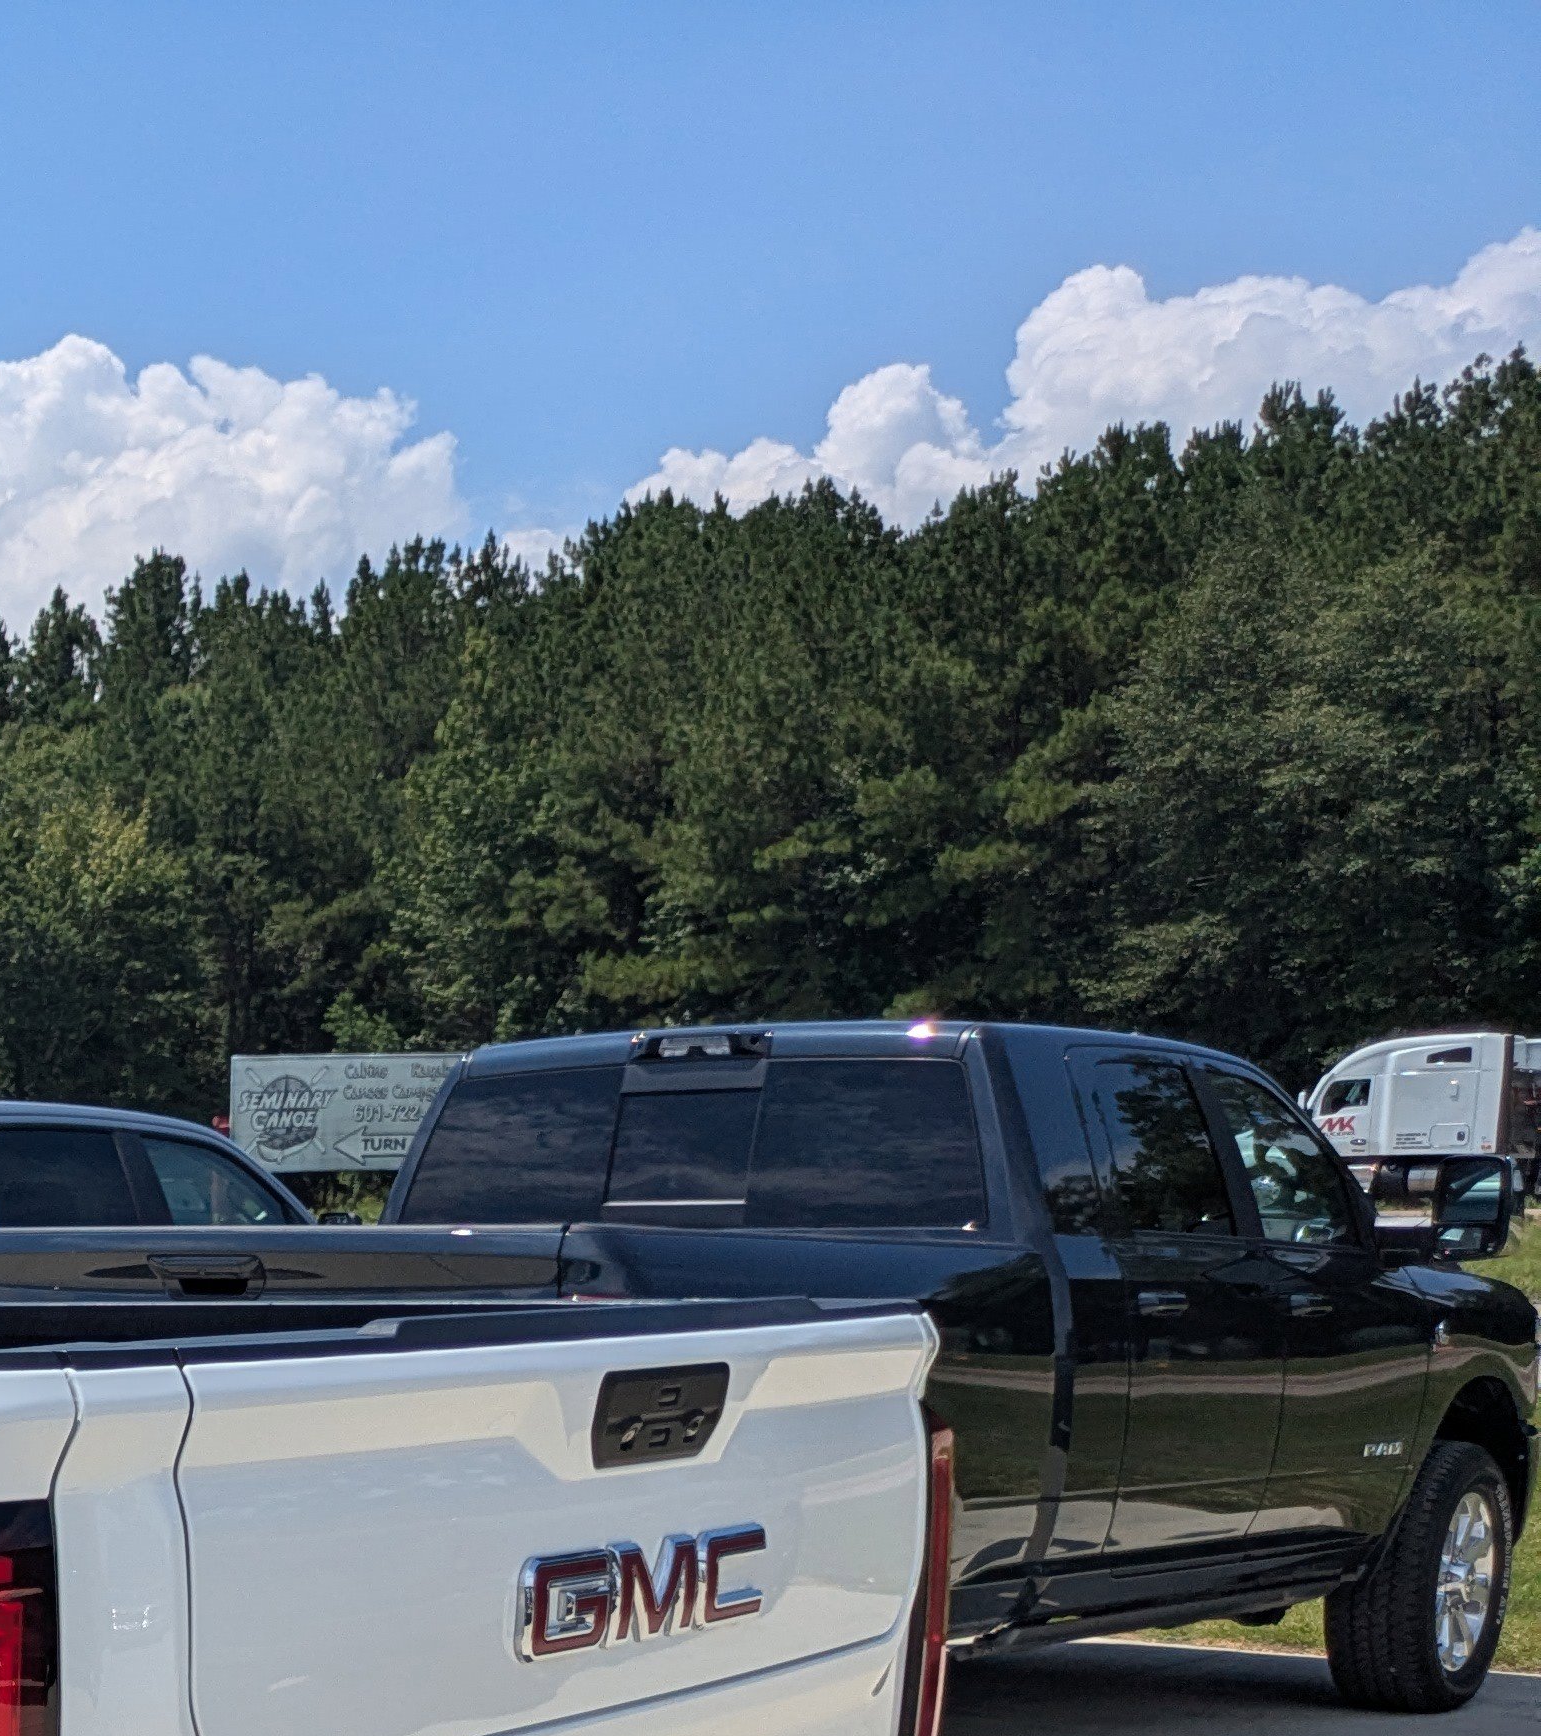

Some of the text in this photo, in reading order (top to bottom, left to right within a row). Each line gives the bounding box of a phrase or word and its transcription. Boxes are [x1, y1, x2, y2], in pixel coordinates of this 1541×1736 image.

[237, 1089, 337, 1113] SEMINARY
[250, 1110, 318, 1132] CANOE
[361, 1138, 408, 1152] TURN
[516, 1522, 766, 1664] GMC
